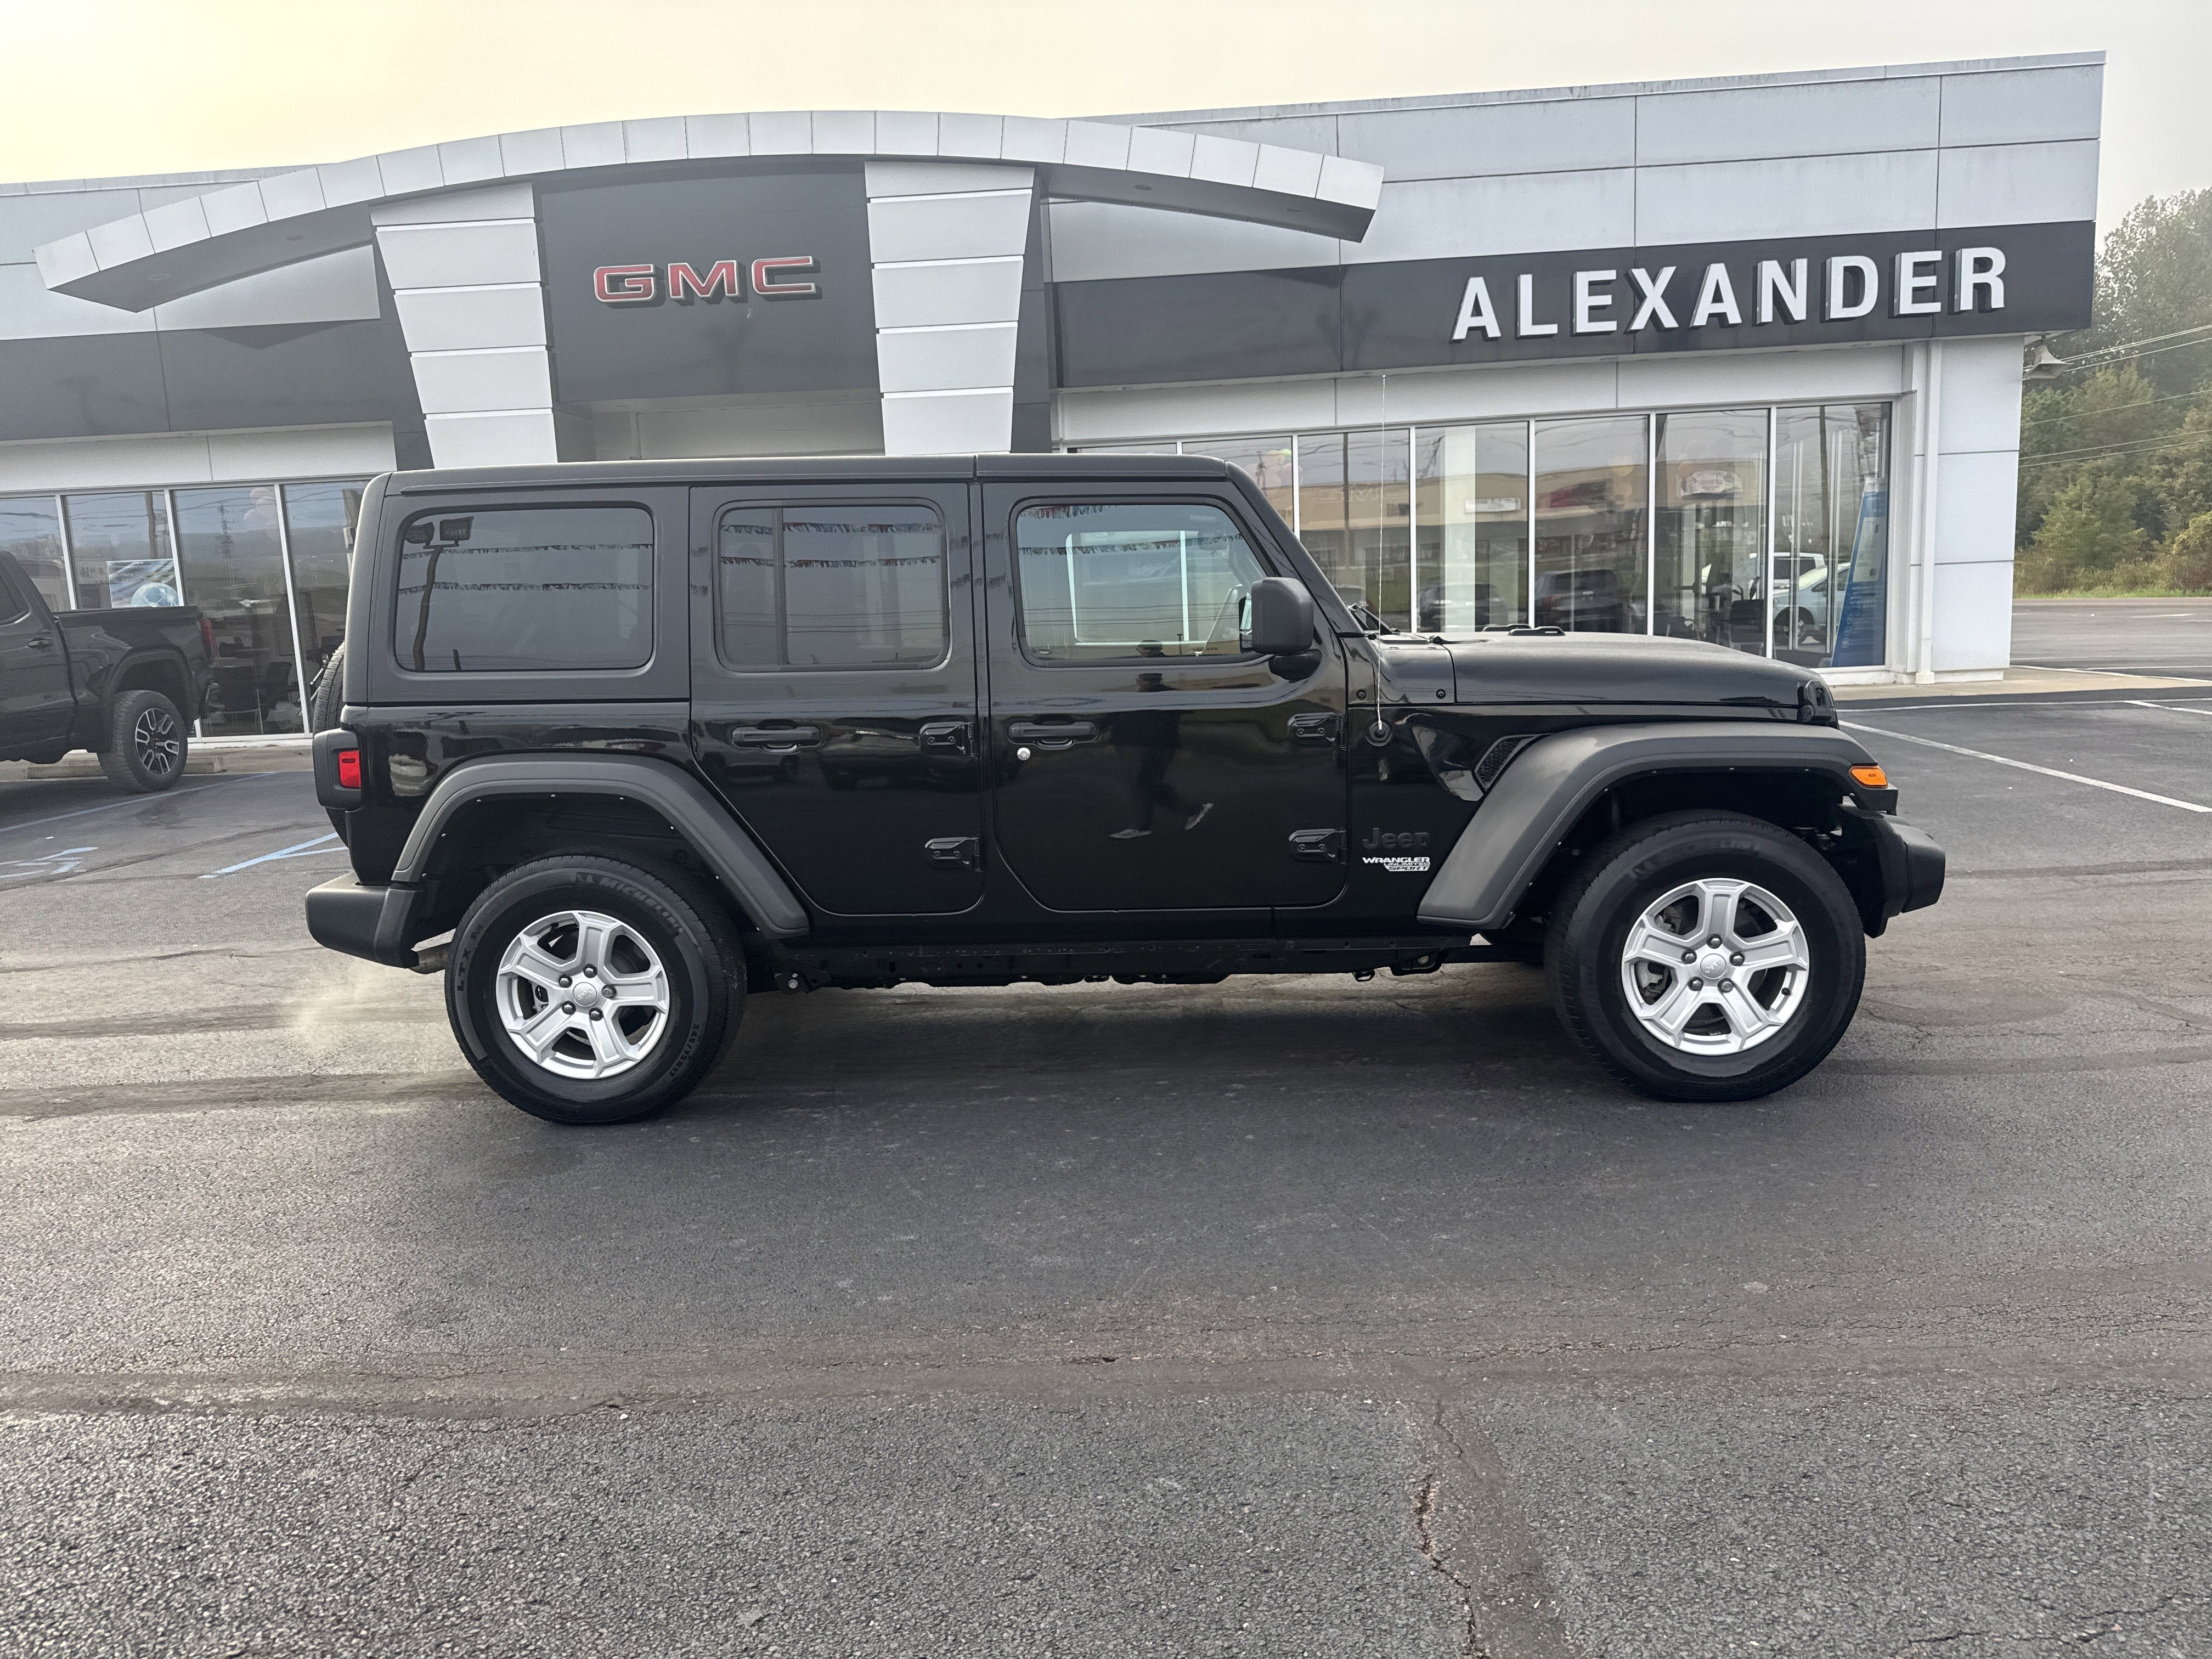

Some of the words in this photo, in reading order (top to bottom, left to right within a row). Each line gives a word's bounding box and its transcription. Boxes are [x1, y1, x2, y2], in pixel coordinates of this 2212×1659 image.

[594, 256, 816, 302] GMC
[1452, 247, 2006, 343] ALEXANDER
[1362, 827, 1430, 850] Jeep
